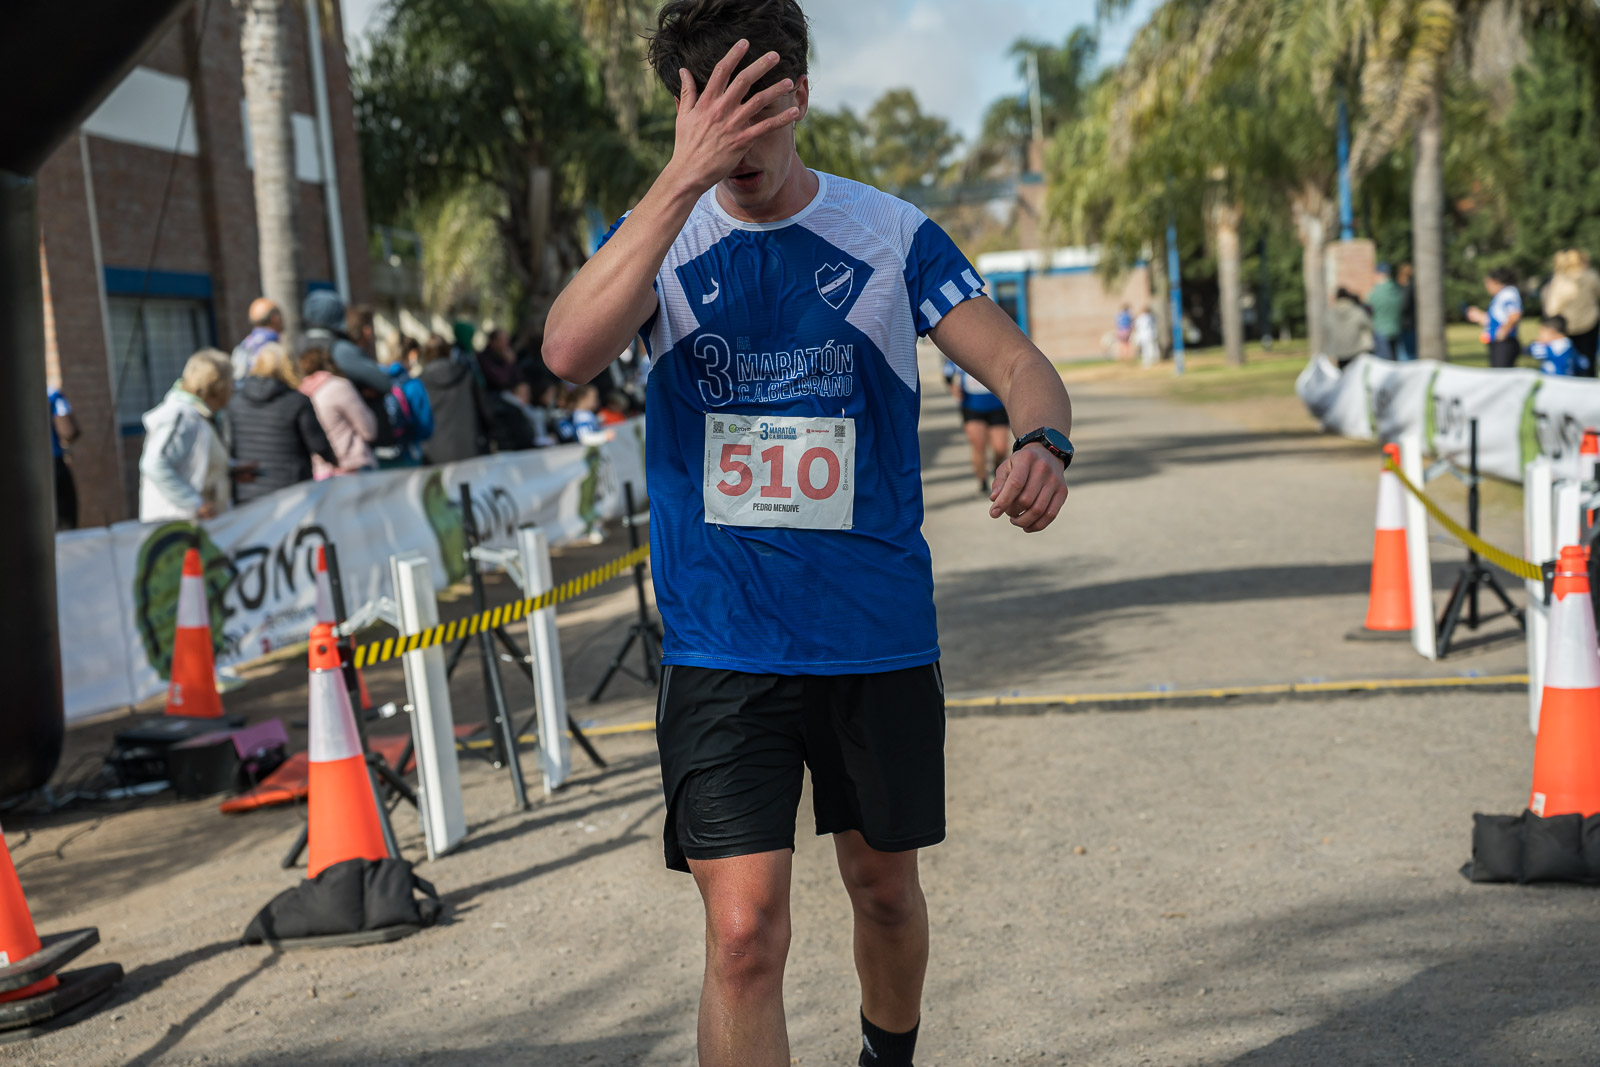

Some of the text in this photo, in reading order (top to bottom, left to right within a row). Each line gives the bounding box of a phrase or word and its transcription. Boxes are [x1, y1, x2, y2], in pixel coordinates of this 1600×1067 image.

[694, 333, 734, 407] 3
[737, 339, 853, 382] MARATÓN
[760, 422, 769, 440] 3
[769, 426, 797, 435] MARATÓN
[716, 443, 840, 500] 510
[752, 502, 800, 513] PEDRO MENDIVE
